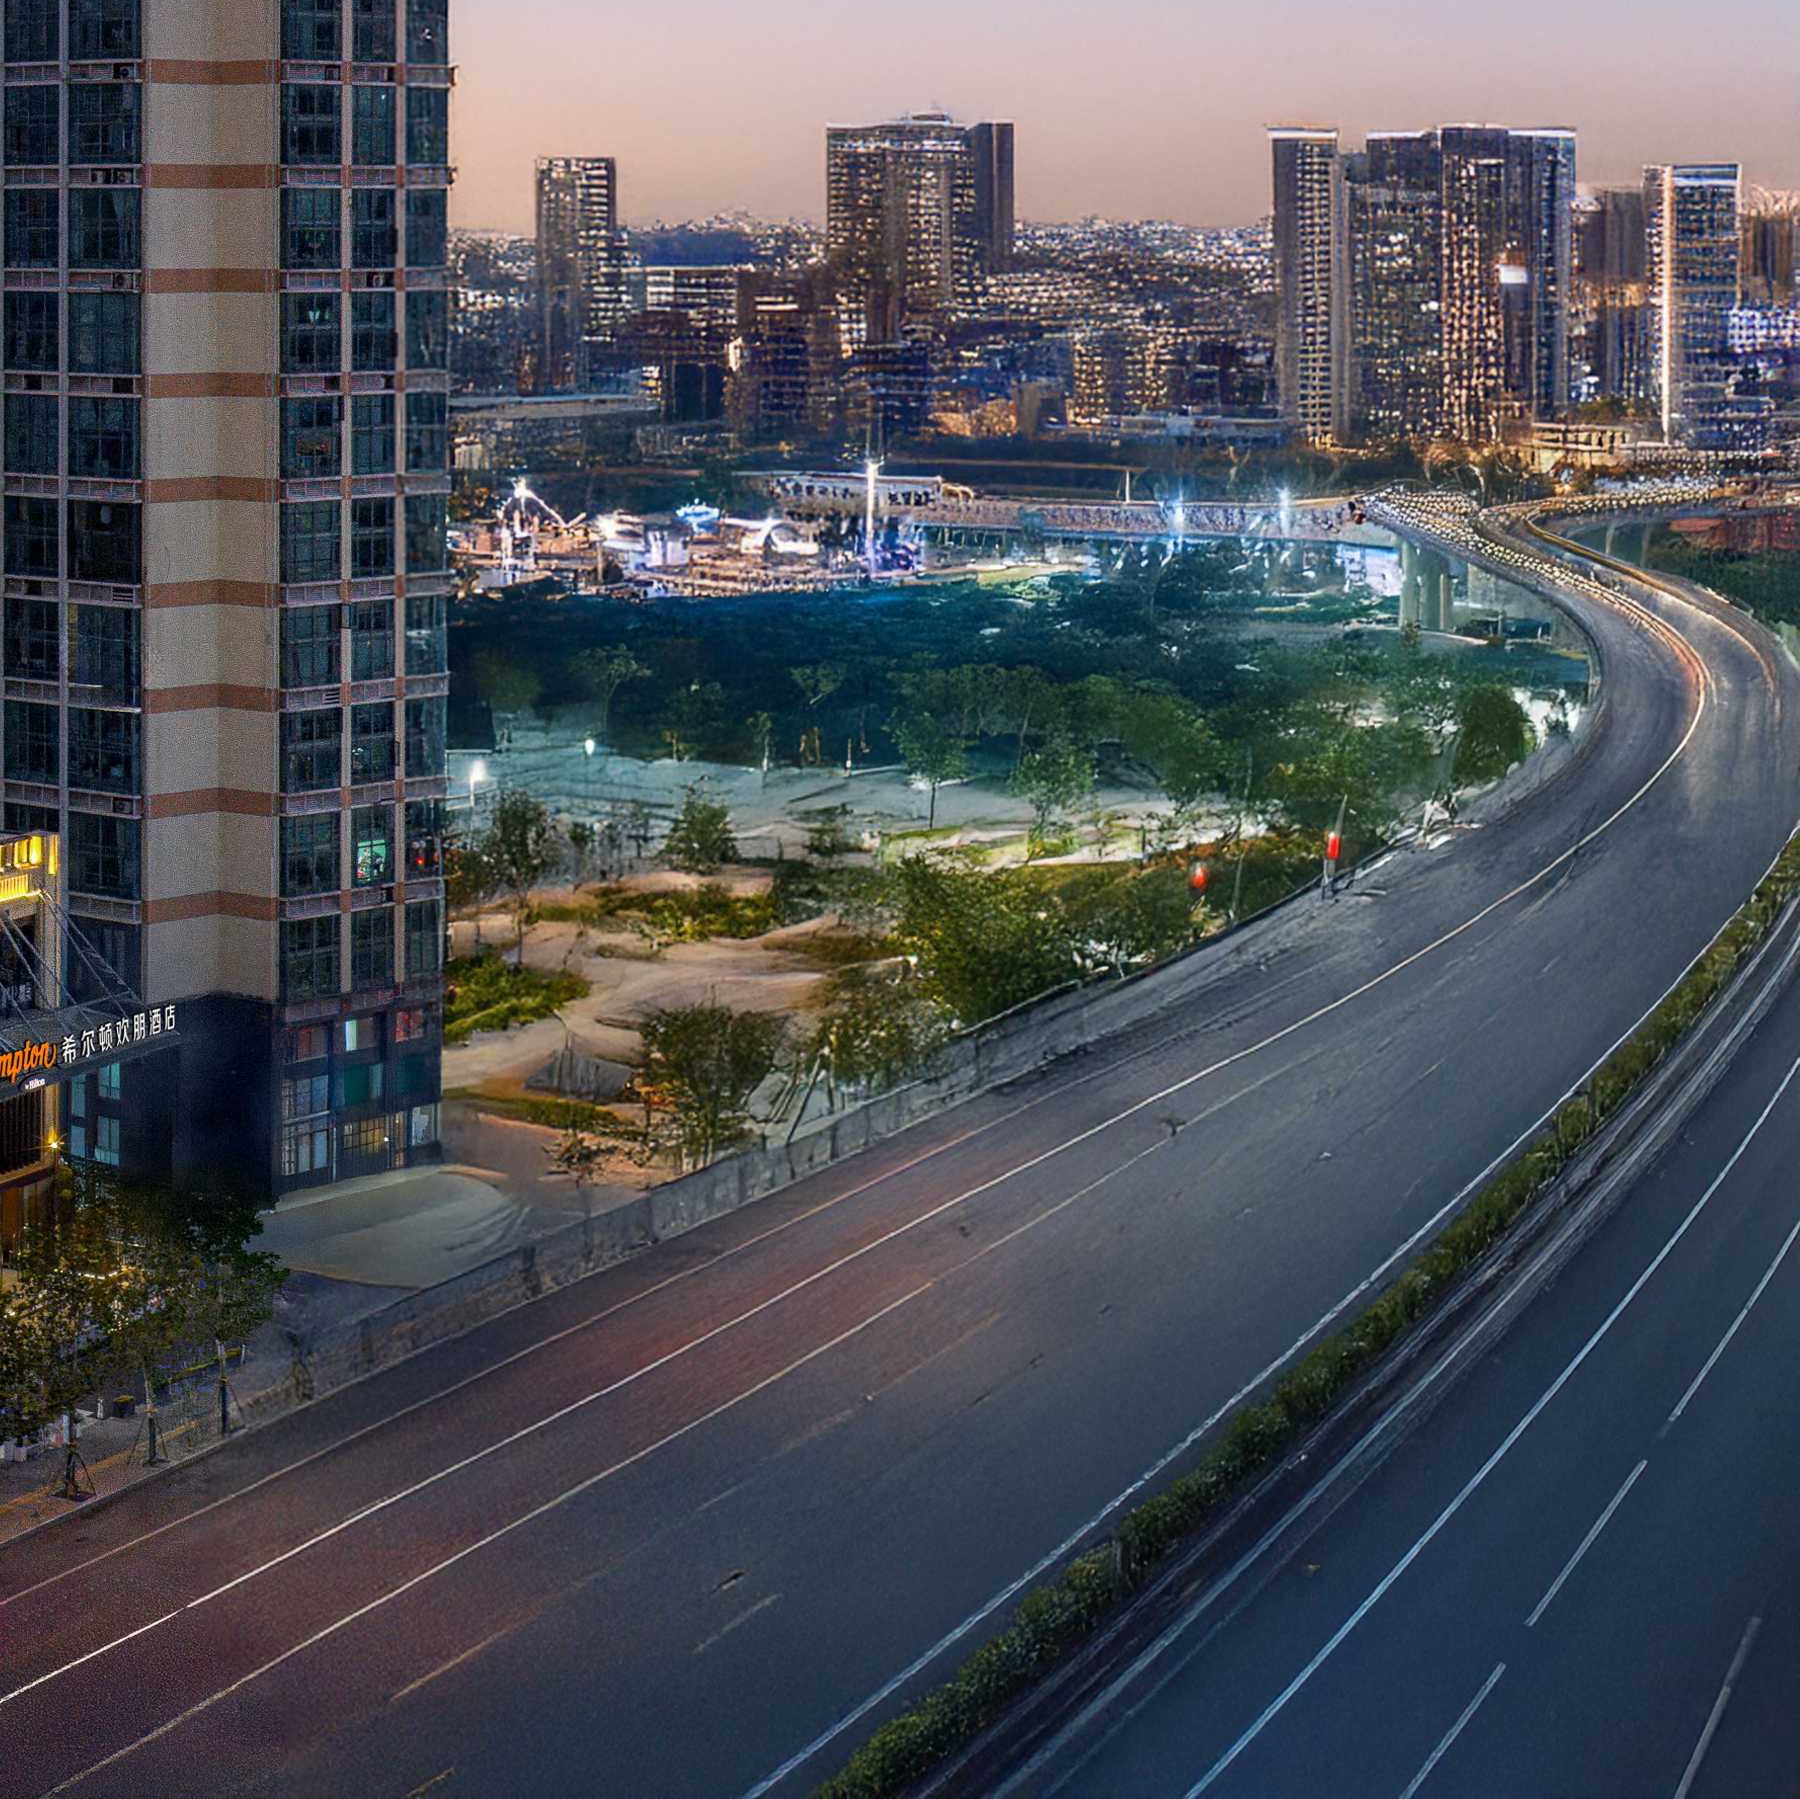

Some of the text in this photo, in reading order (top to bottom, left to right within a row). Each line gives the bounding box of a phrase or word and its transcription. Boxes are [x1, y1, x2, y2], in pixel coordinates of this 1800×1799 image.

[61, 1004, 176, 1064] 希尔顿欢朋酒店
